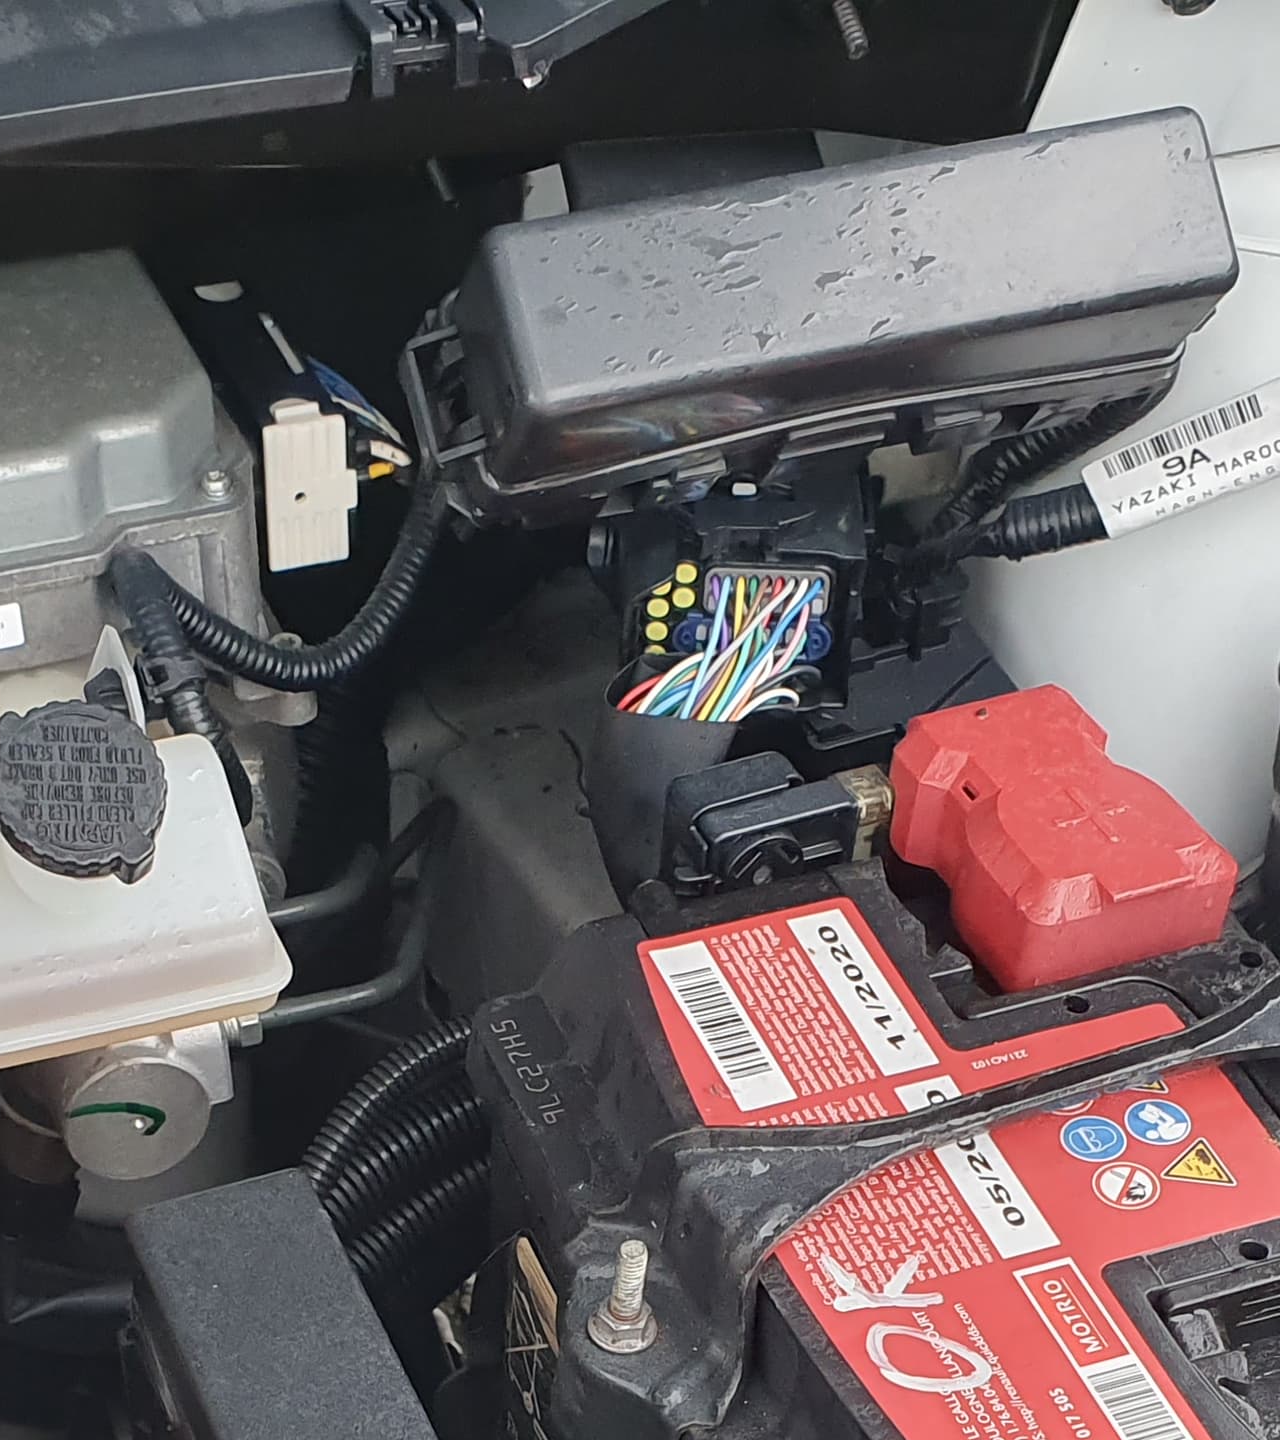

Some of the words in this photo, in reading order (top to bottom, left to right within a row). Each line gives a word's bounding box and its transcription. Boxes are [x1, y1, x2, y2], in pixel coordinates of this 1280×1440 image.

[1161, 446, 1213, 478] 9A
[1111, 474, 1196, 515] YAZAKI
[818, 926, 907, 1050] 11/2020
[1043, 1279, 1103, 1353] MOTRIO
[1048, 1387, 1074, 1412] 505
[961, 1423, 981, 1439] LE
[1065, 1415, 1091, 1439] 017
